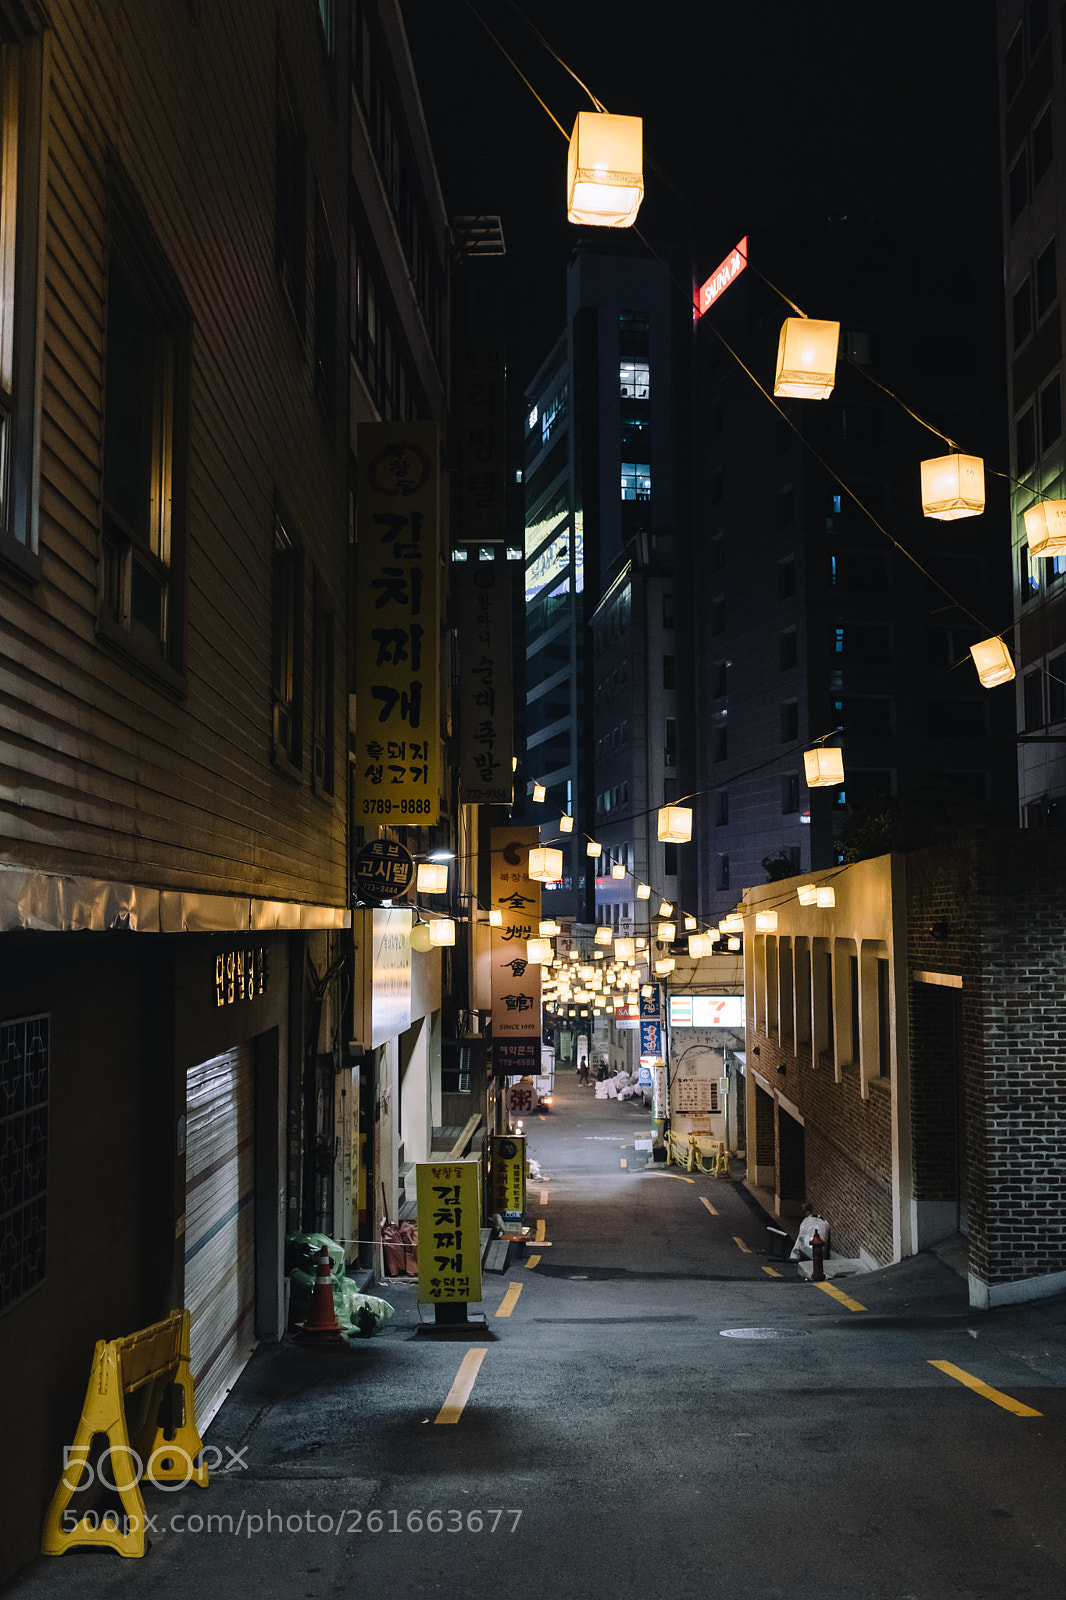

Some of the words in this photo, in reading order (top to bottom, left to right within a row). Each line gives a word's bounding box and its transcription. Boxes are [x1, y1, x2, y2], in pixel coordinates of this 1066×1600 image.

[370, 511, 424, 728] 김치찌개
[364, 764, 428, 784] 생고기
[362, 799, 431, 813] 3789-9888
[371, 843, 399, 857] 토브
[357, 861, 409, 884] 고시텔
[511, 1089, 532, 1111] 粥
[432, 1185, 463, 1273] 김치찌개
[429, 1287, 469, 1298] 생고기
